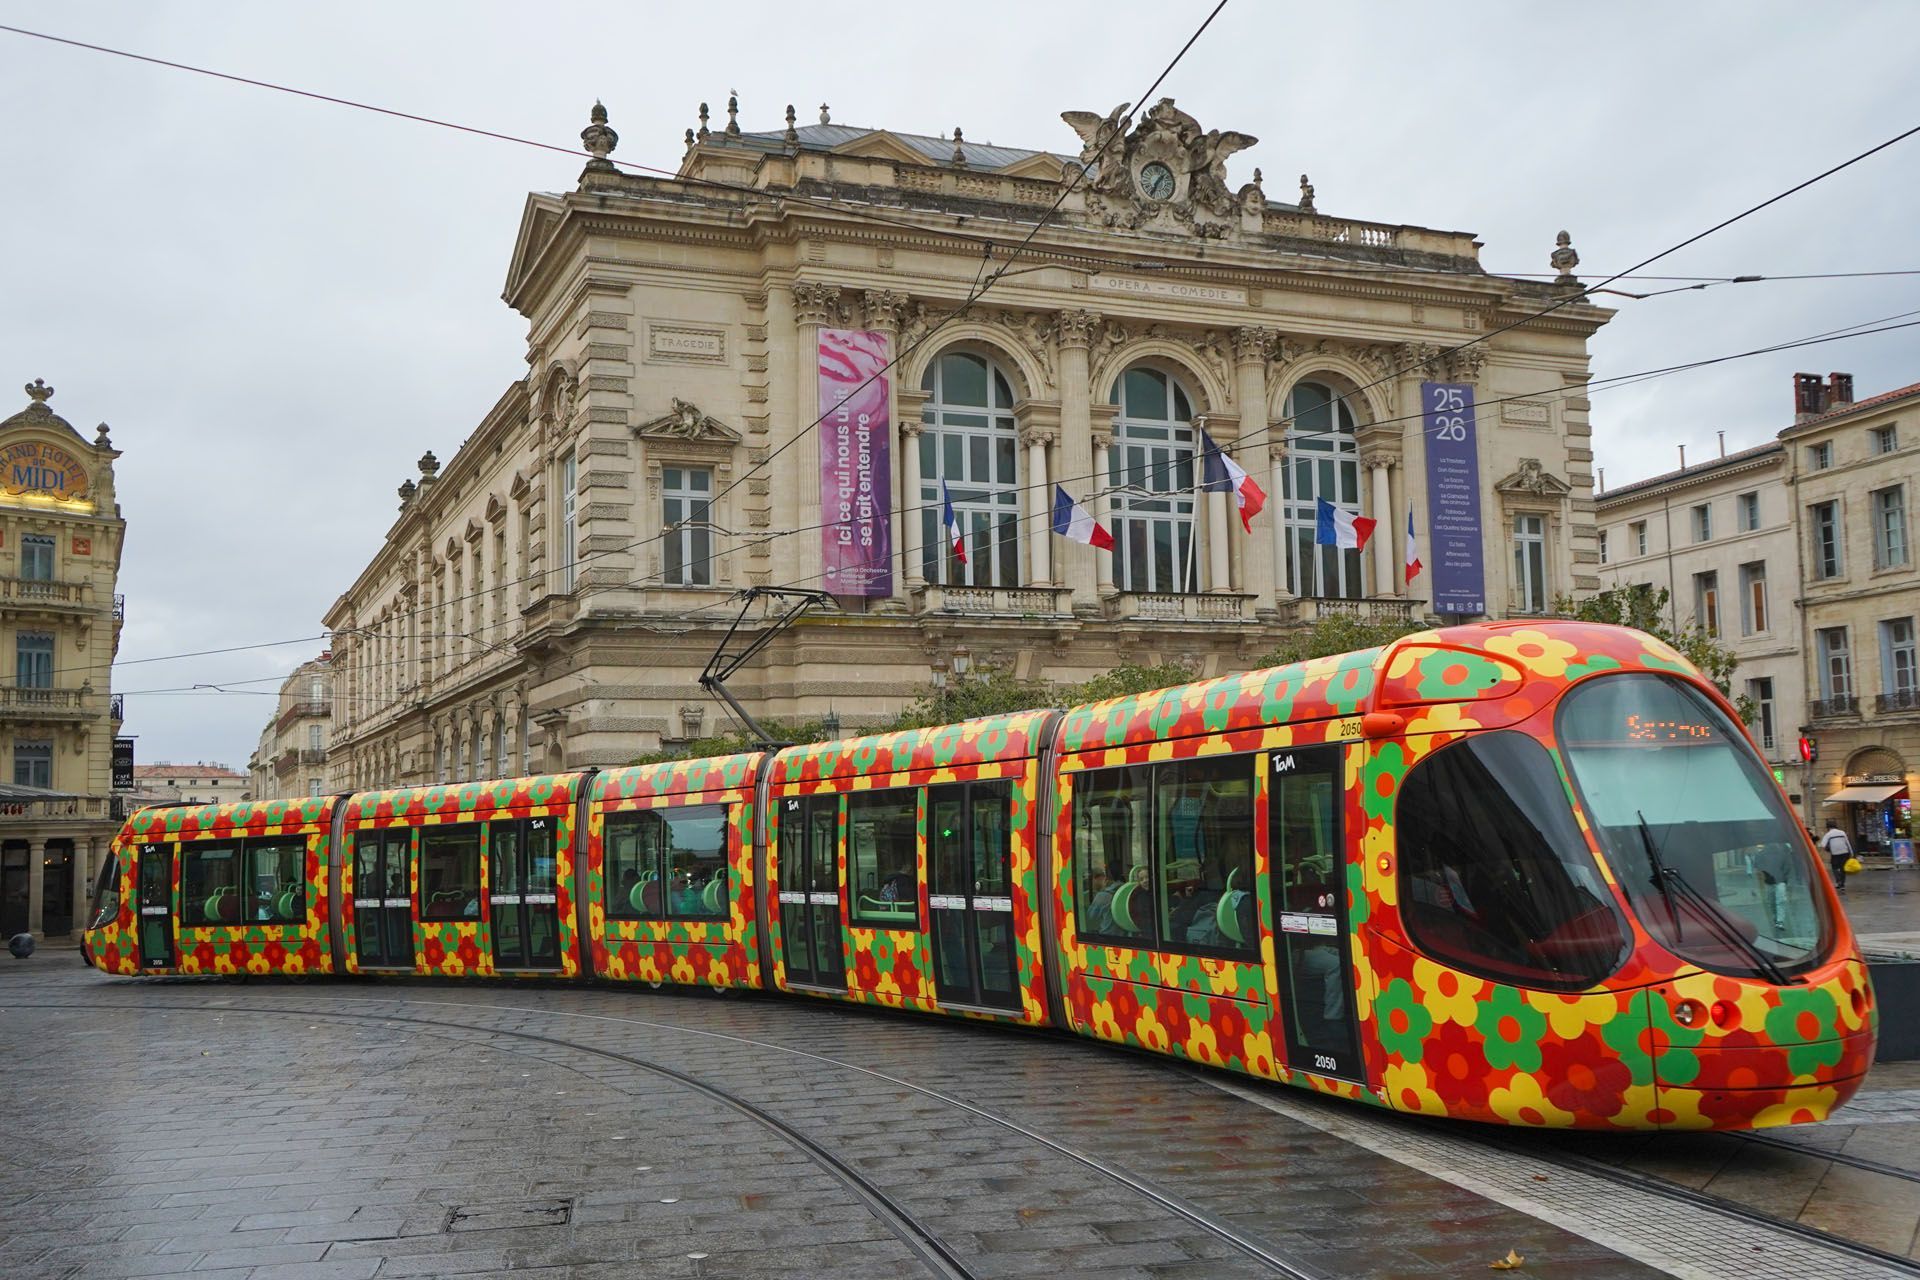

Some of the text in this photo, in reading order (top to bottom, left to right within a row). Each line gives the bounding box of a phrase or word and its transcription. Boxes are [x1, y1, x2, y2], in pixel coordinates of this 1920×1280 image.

[1109, 279, 1150, 291] OPERA
[1171, 286, 1228, 299] COMEDIE
[661, 338, 714, 349] TRAGEDIE
[1434, 388, 1464, 413] 25
[1436, 416, 1466, 441] 26
[12, 464, 65, 490] MIDI
[834, 388, 855, 545] Ici ce qui nous unit
[855, 413, 872, 546] se fait entendre
[1340, 722, 1362, 736] 2050
[1273, 754, 1295, 772] TaM
[1314, 1054, 1337, 1071] 2050
